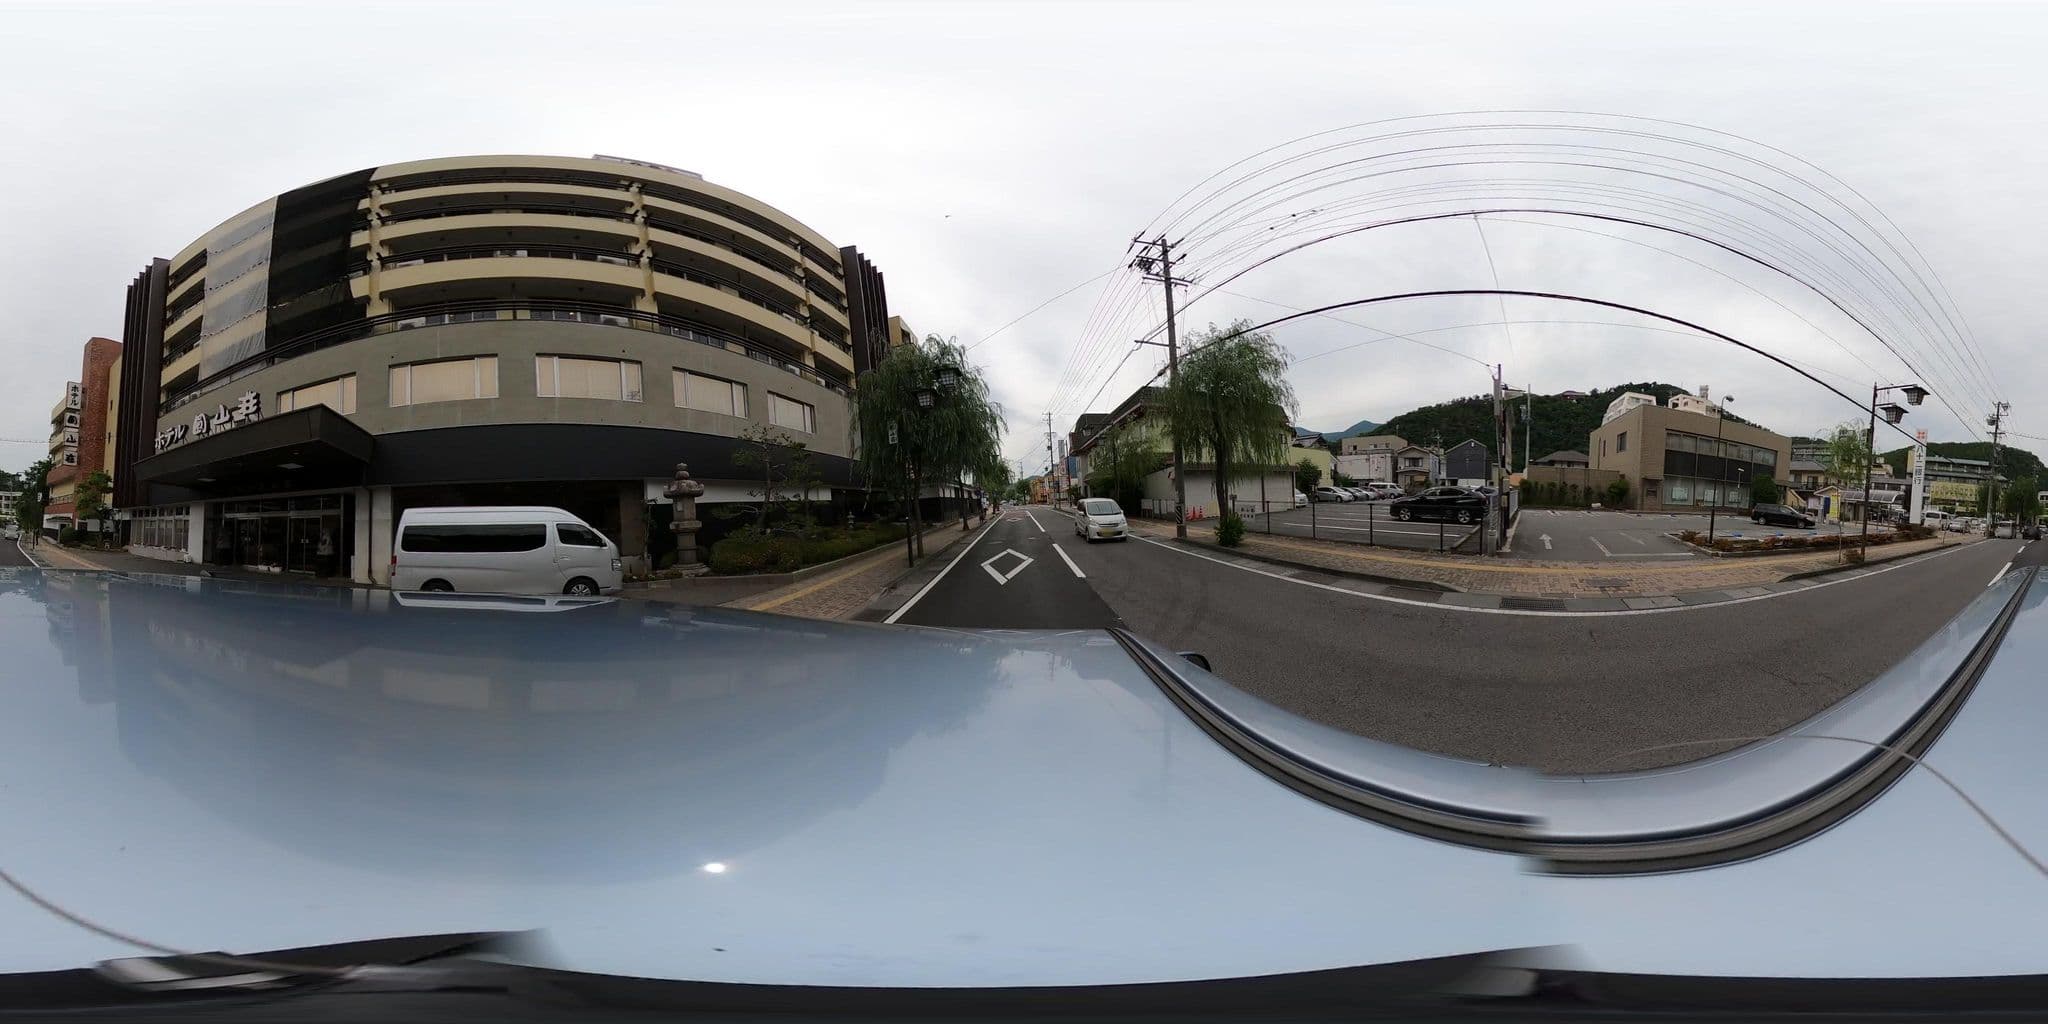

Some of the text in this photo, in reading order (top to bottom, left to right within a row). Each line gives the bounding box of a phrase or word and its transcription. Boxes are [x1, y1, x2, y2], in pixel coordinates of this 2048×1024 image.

[1913, 445, 1924, 485] 八十二銀行
